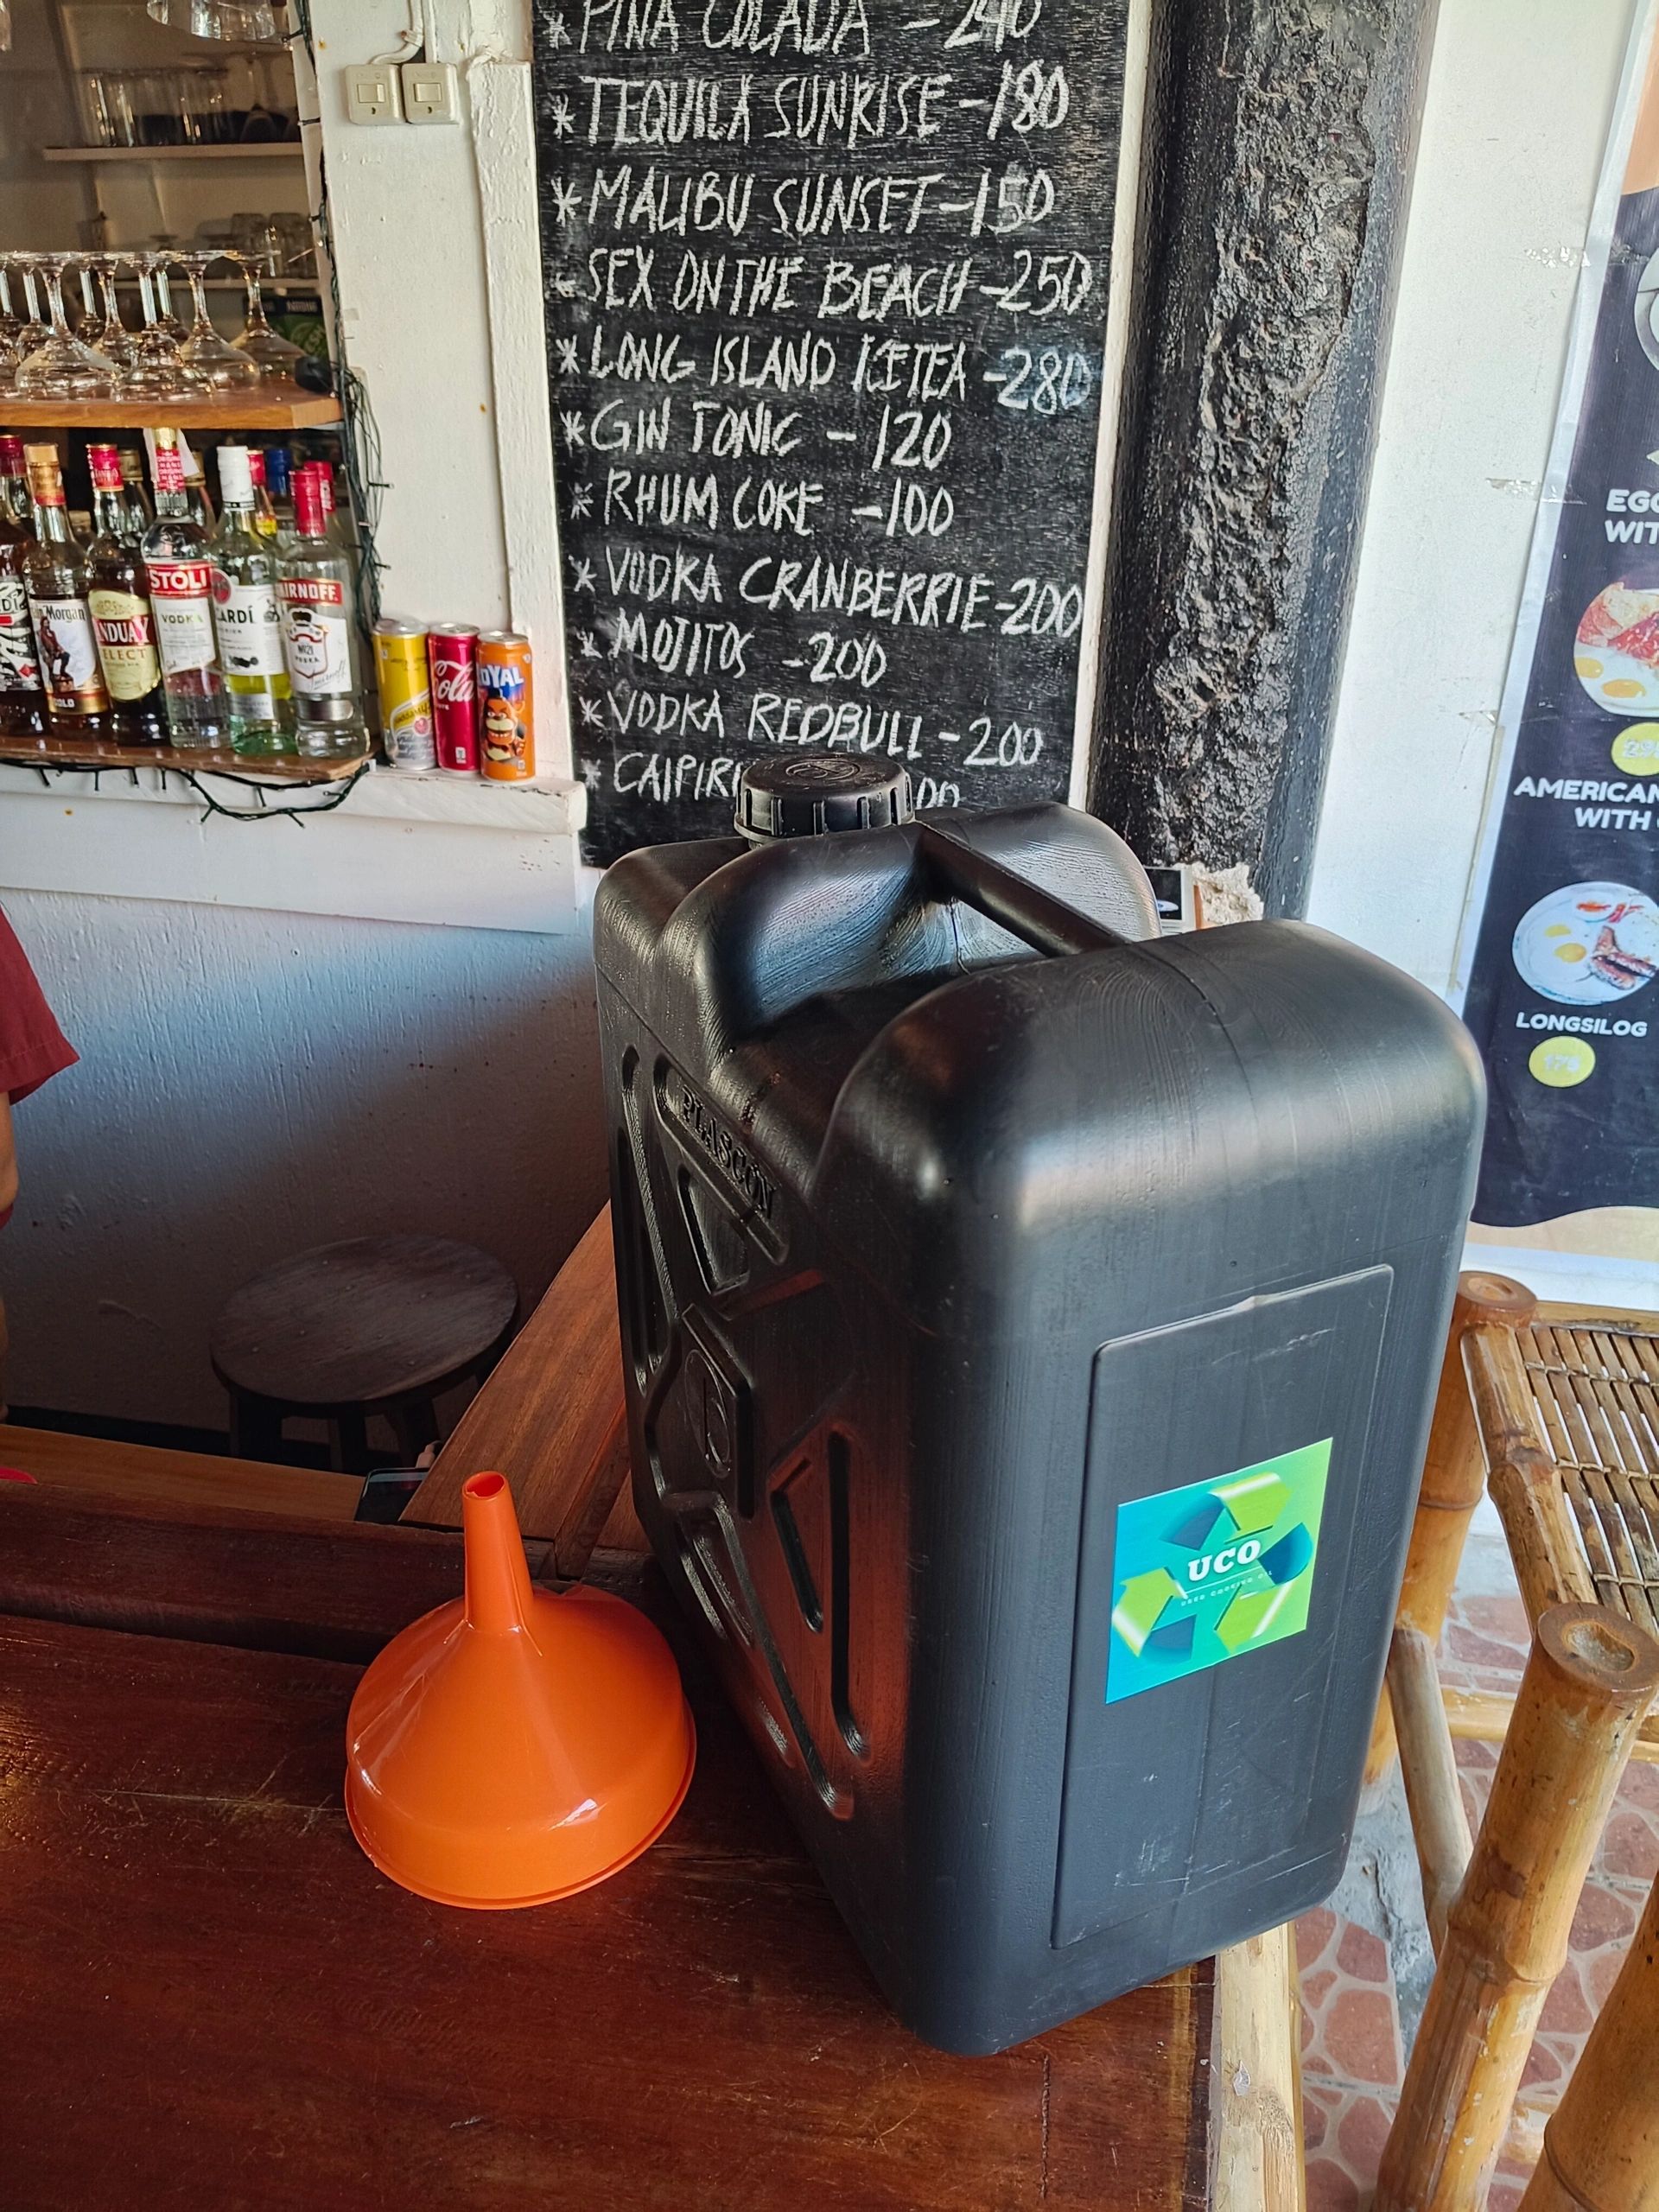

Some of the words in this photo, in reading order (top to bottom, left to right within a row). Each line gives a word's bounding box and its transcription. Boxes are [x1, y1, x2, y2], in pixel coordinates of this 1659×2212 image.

[578, 74, 754, 146] TEQUILA
[764, 71, 953, 149] SUNRISE
[588, 164, 757, 237] MALIBU
[771, 174, 945, 237] SUNSET
[588, 245, 654, 310] SEX
[817, 257, 974, 321] BEACH
[588, 324, 696, 384] LONG
[709, 329, 836, 393] ISLAND
[590, 396, 672, 455] GIN
[690, 400, 803, 459] TONIC
[604, 467, 720, 530] RHUM
[733, 475, 823, 537] COKE
[44, 605, 86, 622] Morgan
[149, 569, 207, 590] STOLI
[606, 543, 724, 604] VODKA
[739, 555, 994, 633] CRANBERRIE
[477, 664, 524, 689] OYAL
[610, 607, 755, 679] MOJITOS
[607, 690, 725, 739] VODKA
[747, 693, 924, 760] REDBULL
[1574, 806, 1652, 831] WITH
[1516, 1011, 1649, 1038] LONGSILOG
[1187, 1540, 1262, 1582] UCO
